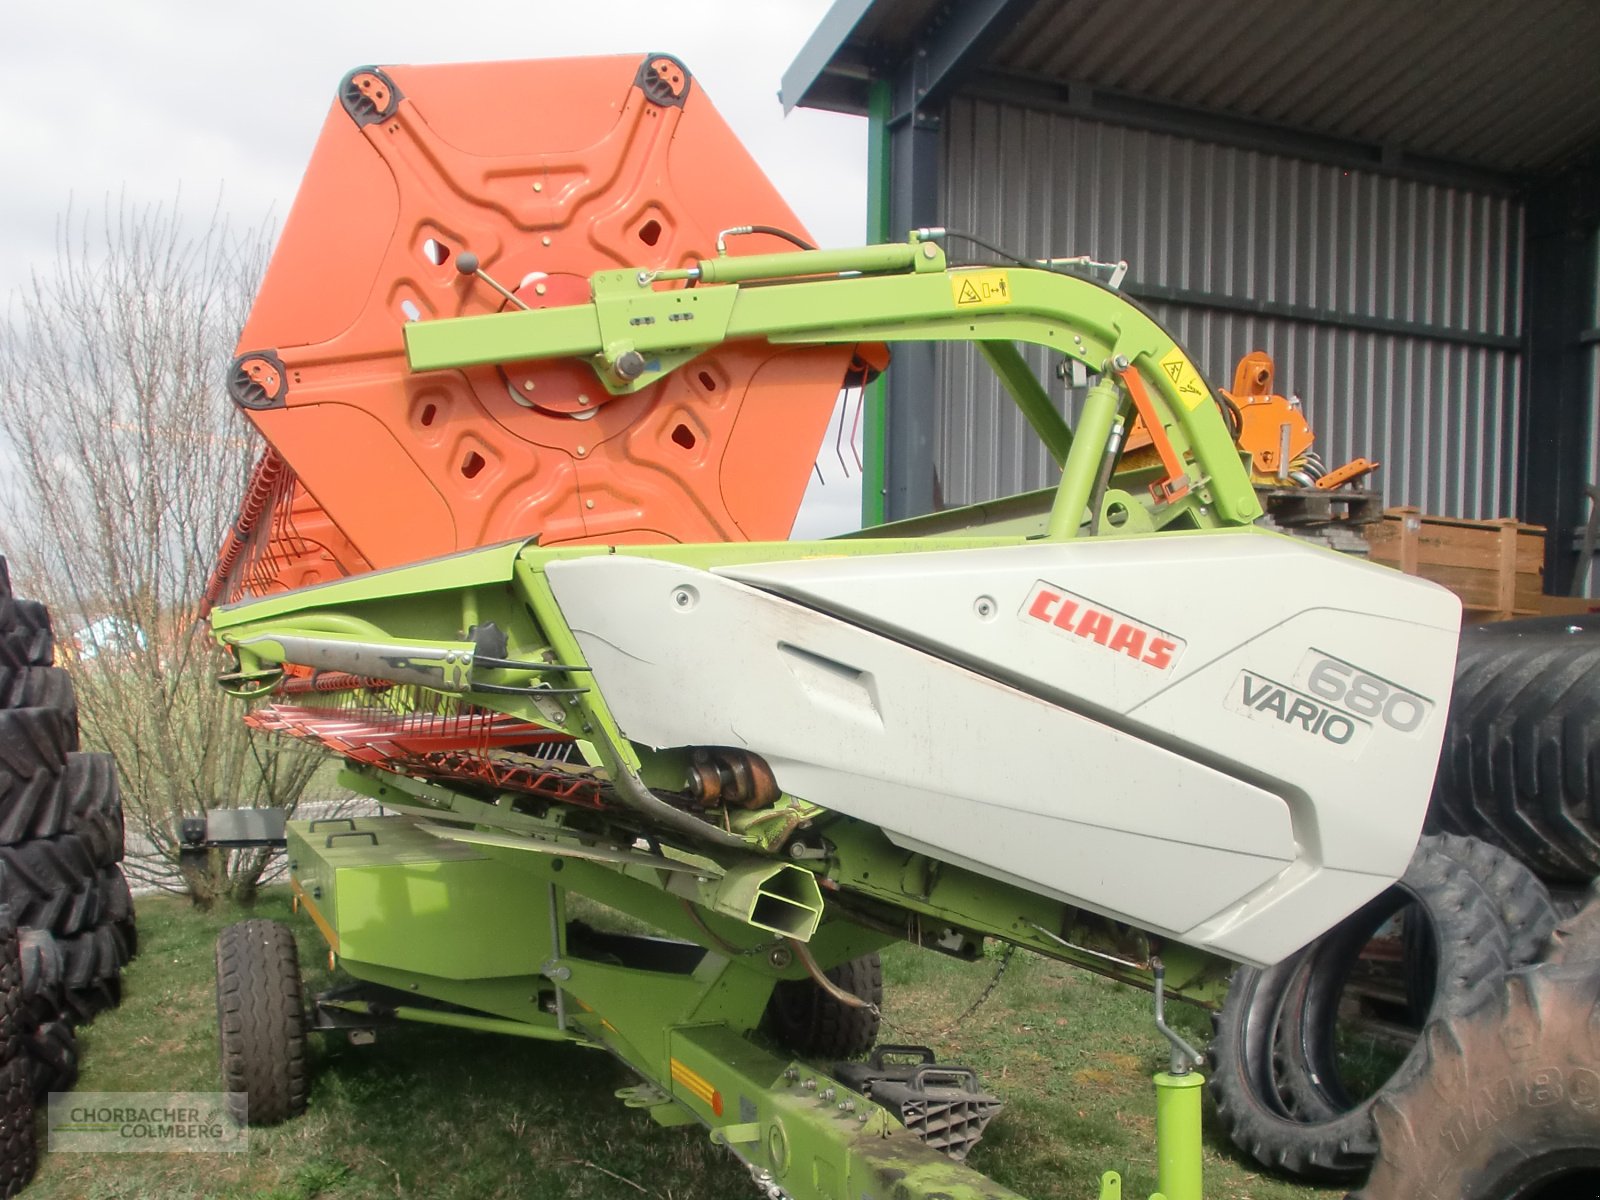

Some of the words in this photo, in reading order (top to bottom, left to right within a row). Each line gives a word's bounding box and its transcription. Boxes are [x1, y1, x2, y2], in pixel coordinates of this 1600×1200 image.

[1028, 590, 1177, 670] CLAAS
[1242, 675, 1355, 745] VARIO
[1308, 658, 1426, 733] 680
